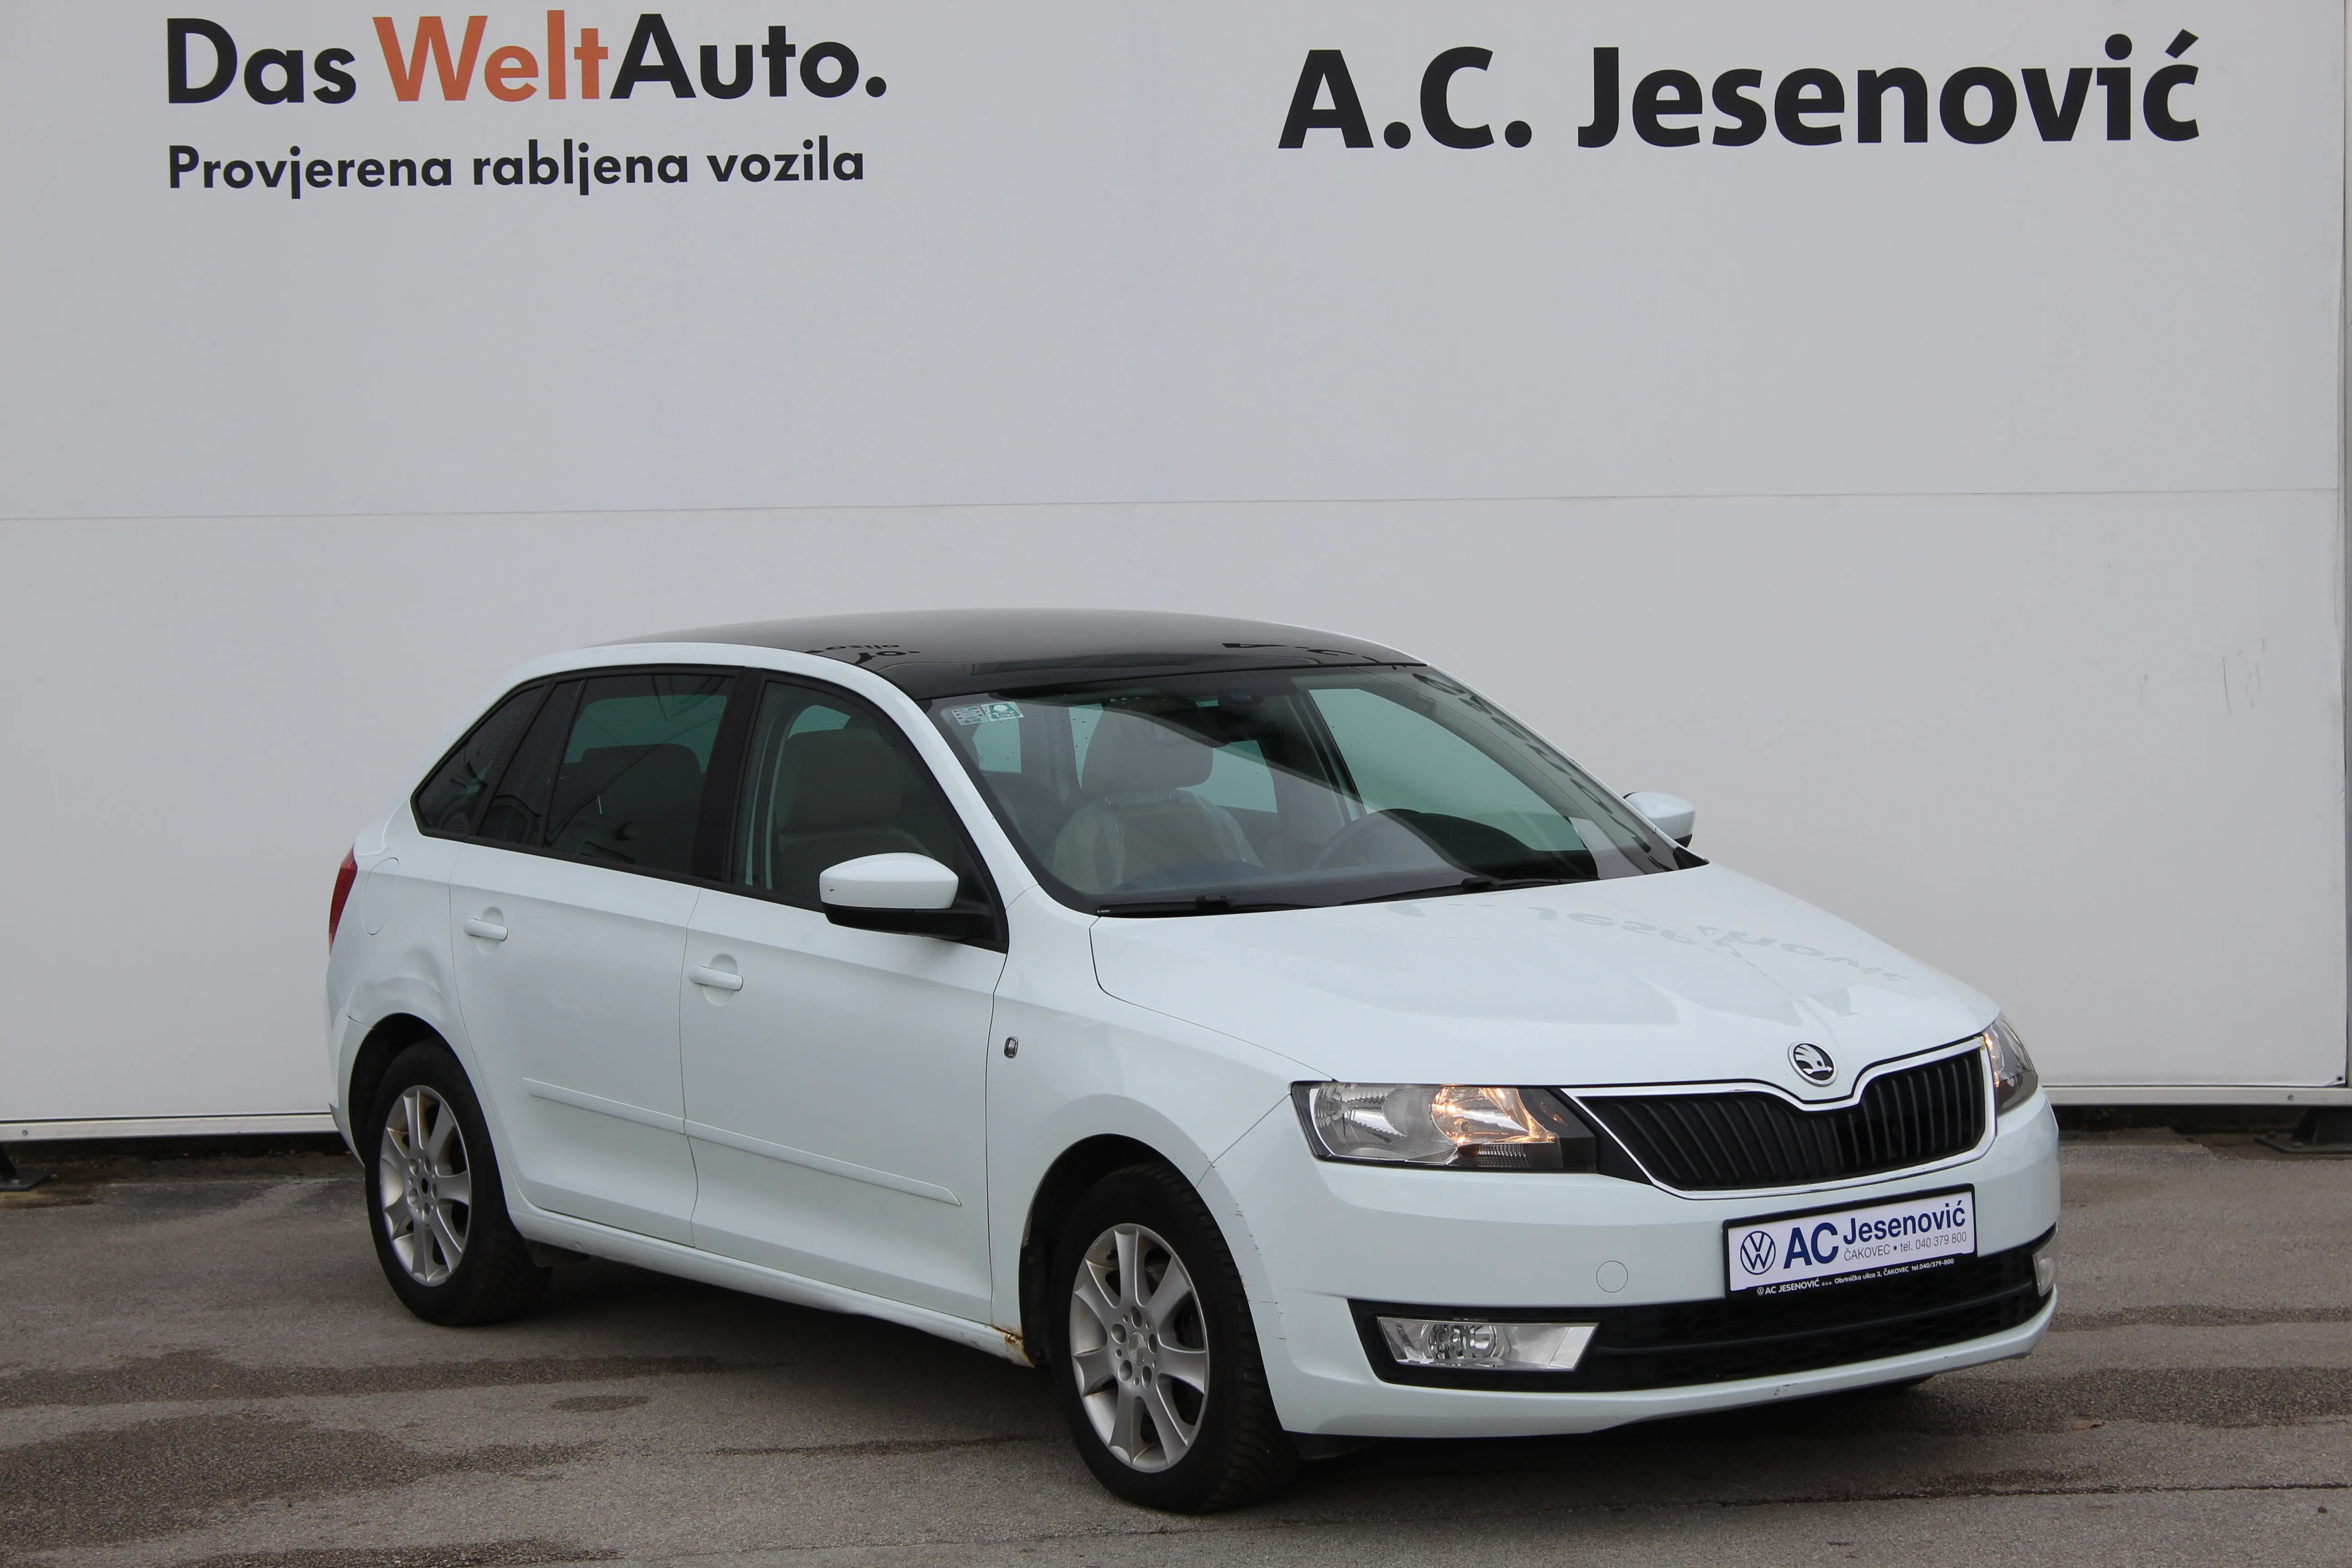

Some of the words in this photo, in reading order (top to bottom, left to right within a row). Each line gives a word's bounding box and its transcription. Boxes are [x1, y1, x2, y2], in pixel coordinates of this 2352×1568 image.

[167, 17, 356, 105] Das
[372, 10, 887, 102] WeltAuto.
[1278, 46, 1533, 150] A.C.
[1577, 28, 2200, 148] Jesenović
[169, 145, 452, 200] Provjerena
[473, 138, 689, 196] rabljena
[706, 135, 863, 183] vozila
[1783, 1222, 1839, 1269] AC
[1843, 1200, 1966, 1245] Jesenović
[1844, 1244, 1891, 1261] ČAKOVEC
[1900, 1240, 1913, 1252] tel.
[1916, 1237, 1931, 1250] 040
[1934, 1234, 1949, 1247] 379
[1951, 1231, 1967, 1244] 800
[1765, 1286, 1776, 1294] AC
[1778, 1278, 1820, 1293] JESENOVIĆ
[1834, 1276, 1862, 1284] Obrtnička
[1883, 1266, 1909, 1276] ČAKOVEC
[1911, 1258, 1954, 1271] tel.040/379-800
